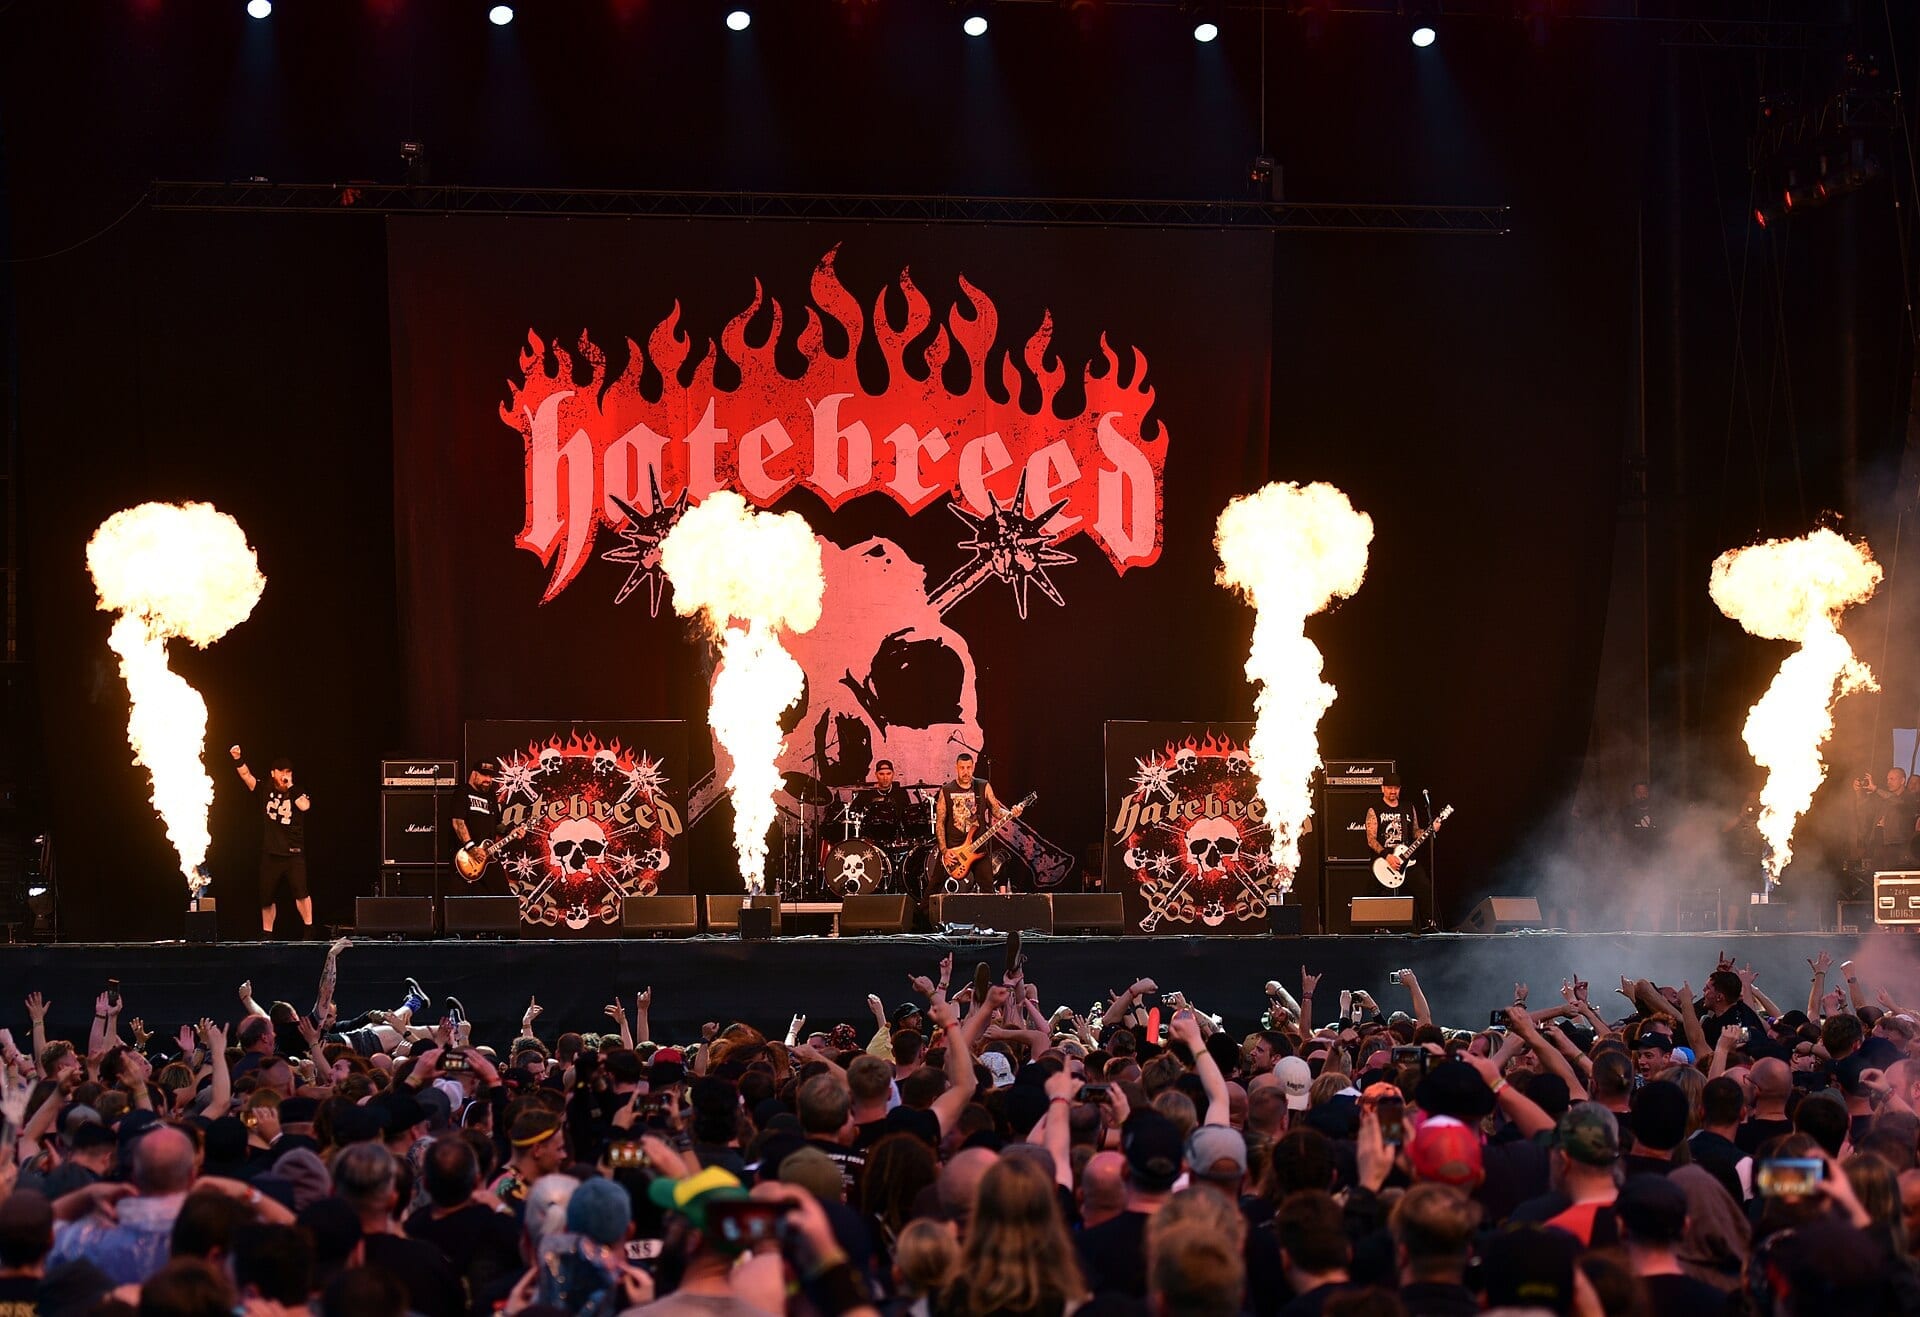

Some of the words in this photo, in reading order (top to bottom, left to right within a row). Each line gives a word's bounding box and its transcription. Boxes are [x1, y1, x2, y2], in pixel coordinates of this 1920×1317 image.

[522, 390, 1157, 599] hatebreed
[1345, 765, 1375, 774] Marshall
[266, 797, 293, 825] 24
[501, 793, 683, 838] atebreed
[1111, 793, 1312, 847] hatebre
